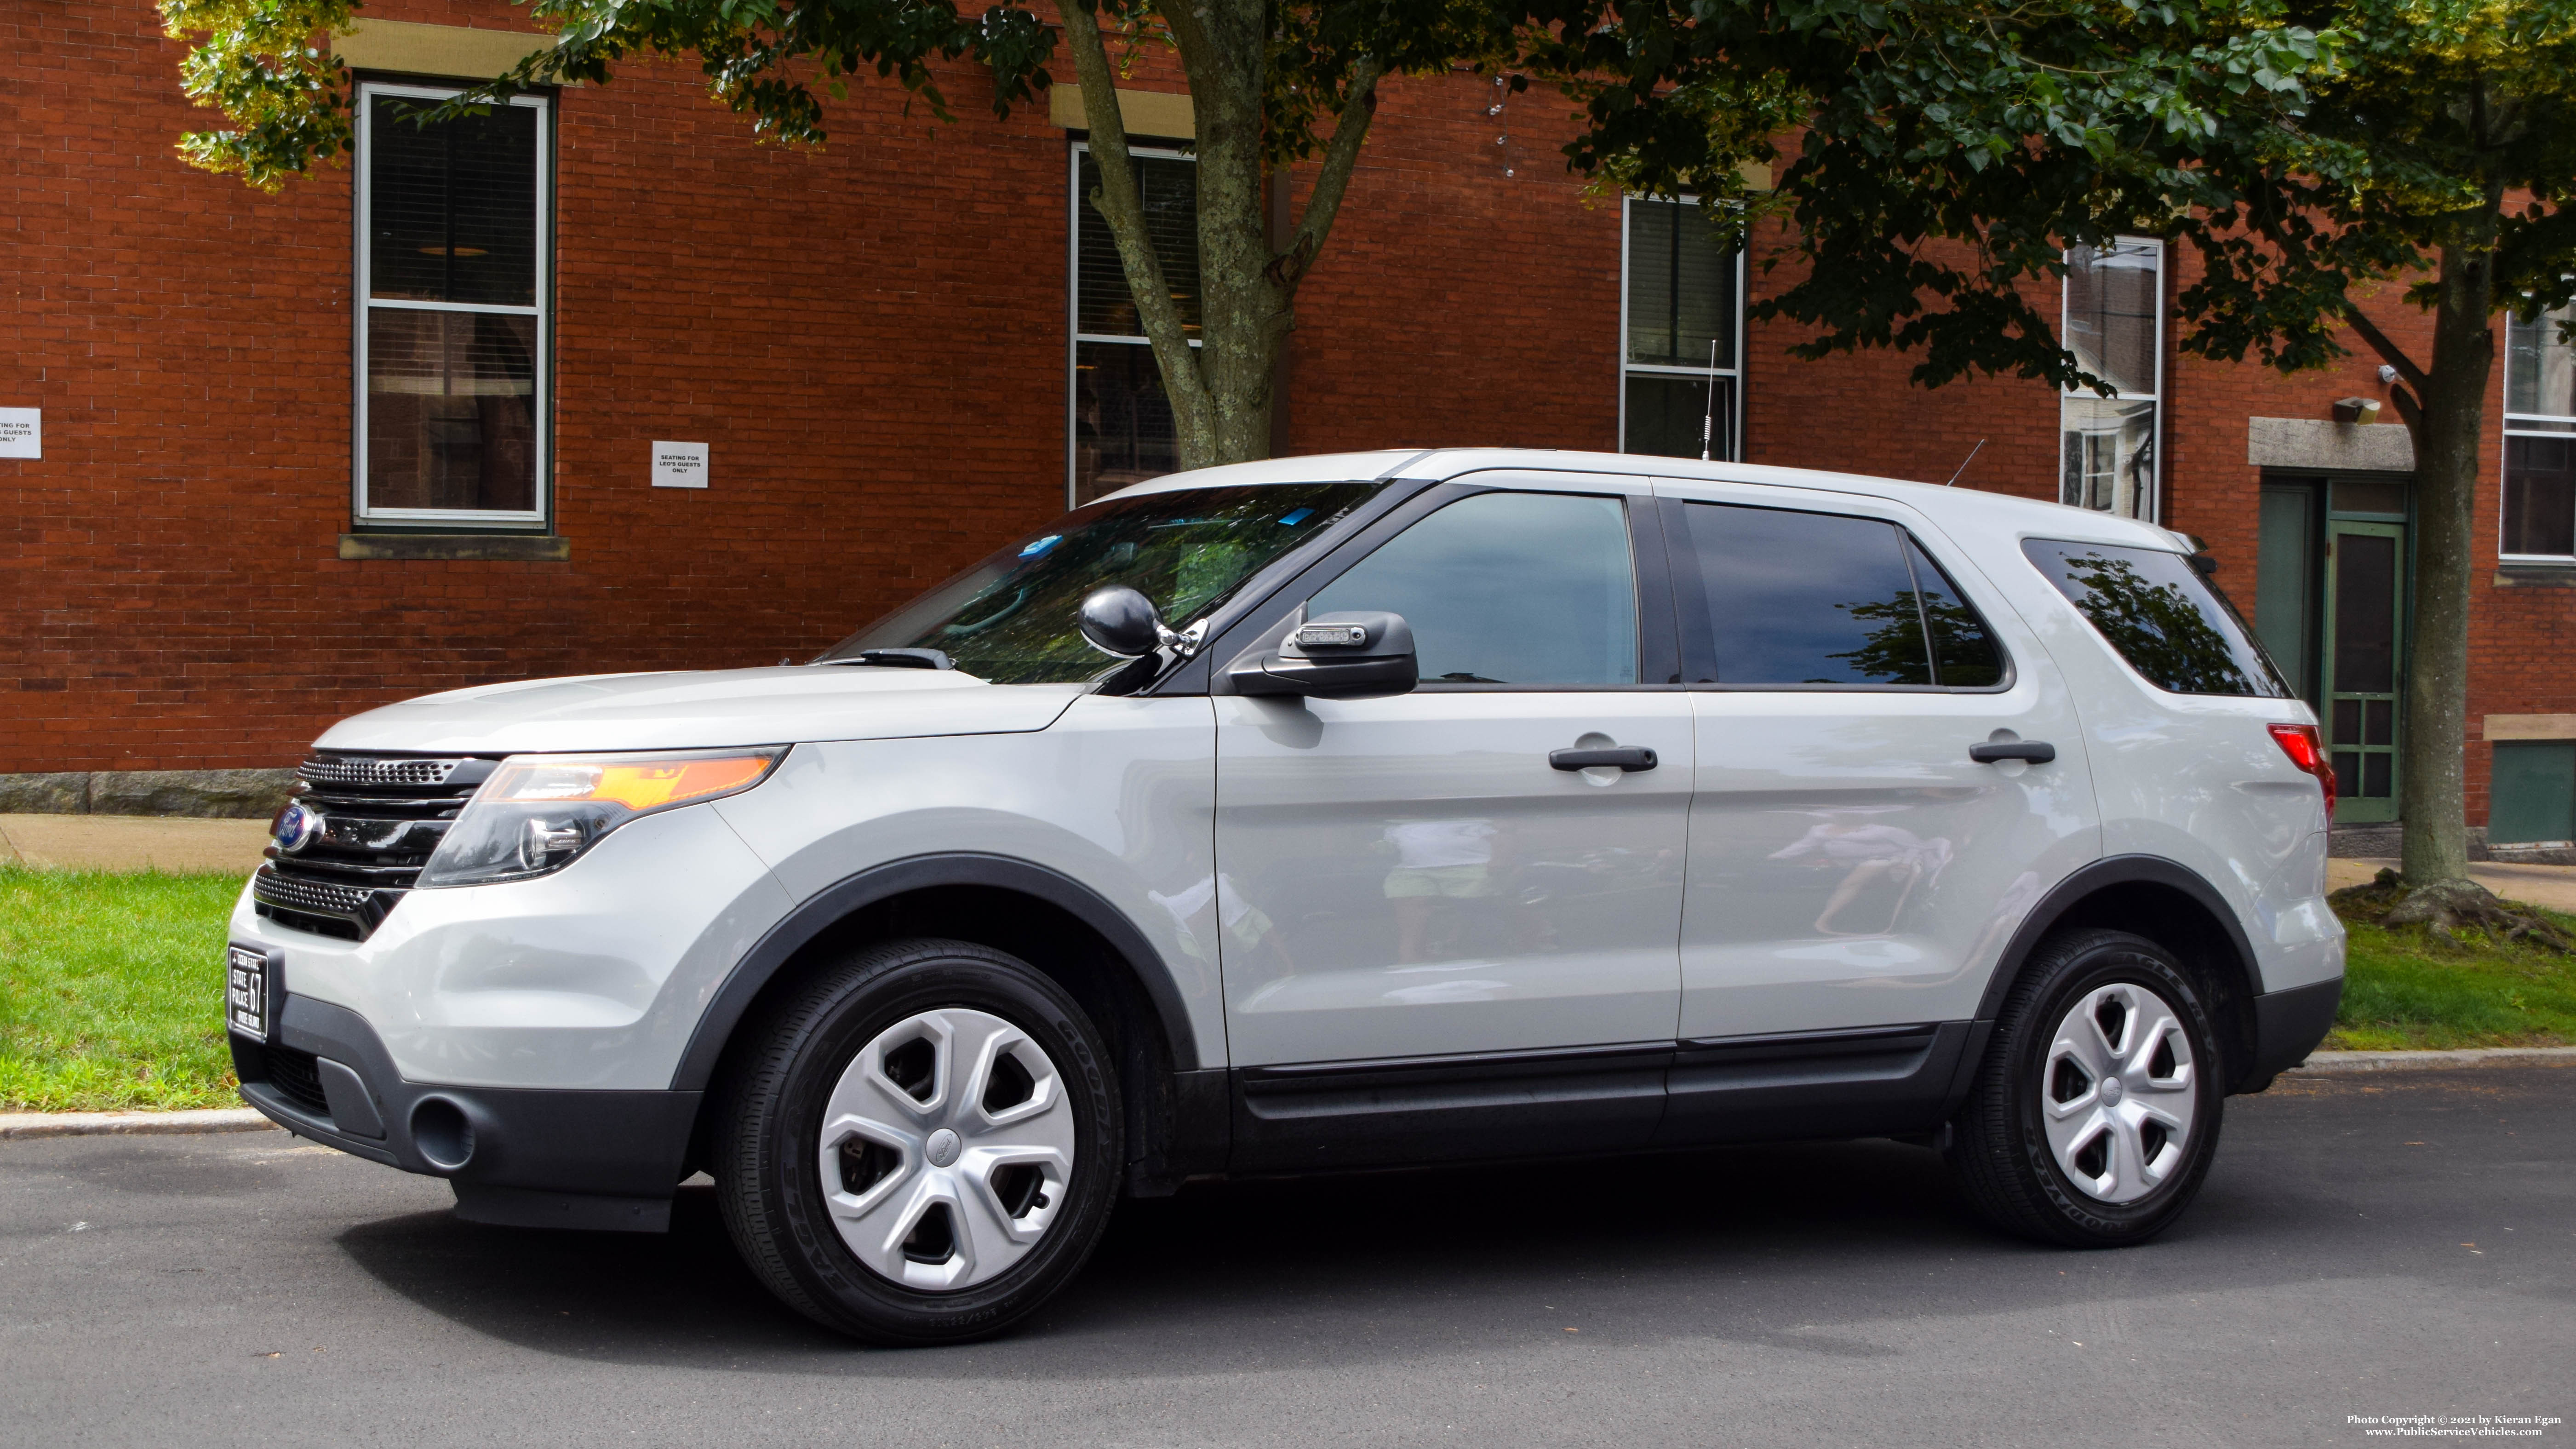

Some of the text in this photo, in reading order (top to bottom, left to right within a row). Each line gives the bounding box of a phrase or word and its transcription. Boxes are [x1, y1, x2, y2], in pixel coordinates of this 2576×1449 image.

[279, 812, 299, 838] Ford
[233, 969, 247, 987] STATE
[232, 987, 248, 1008] POLICE
[250, 973, 261, 1014] 67
